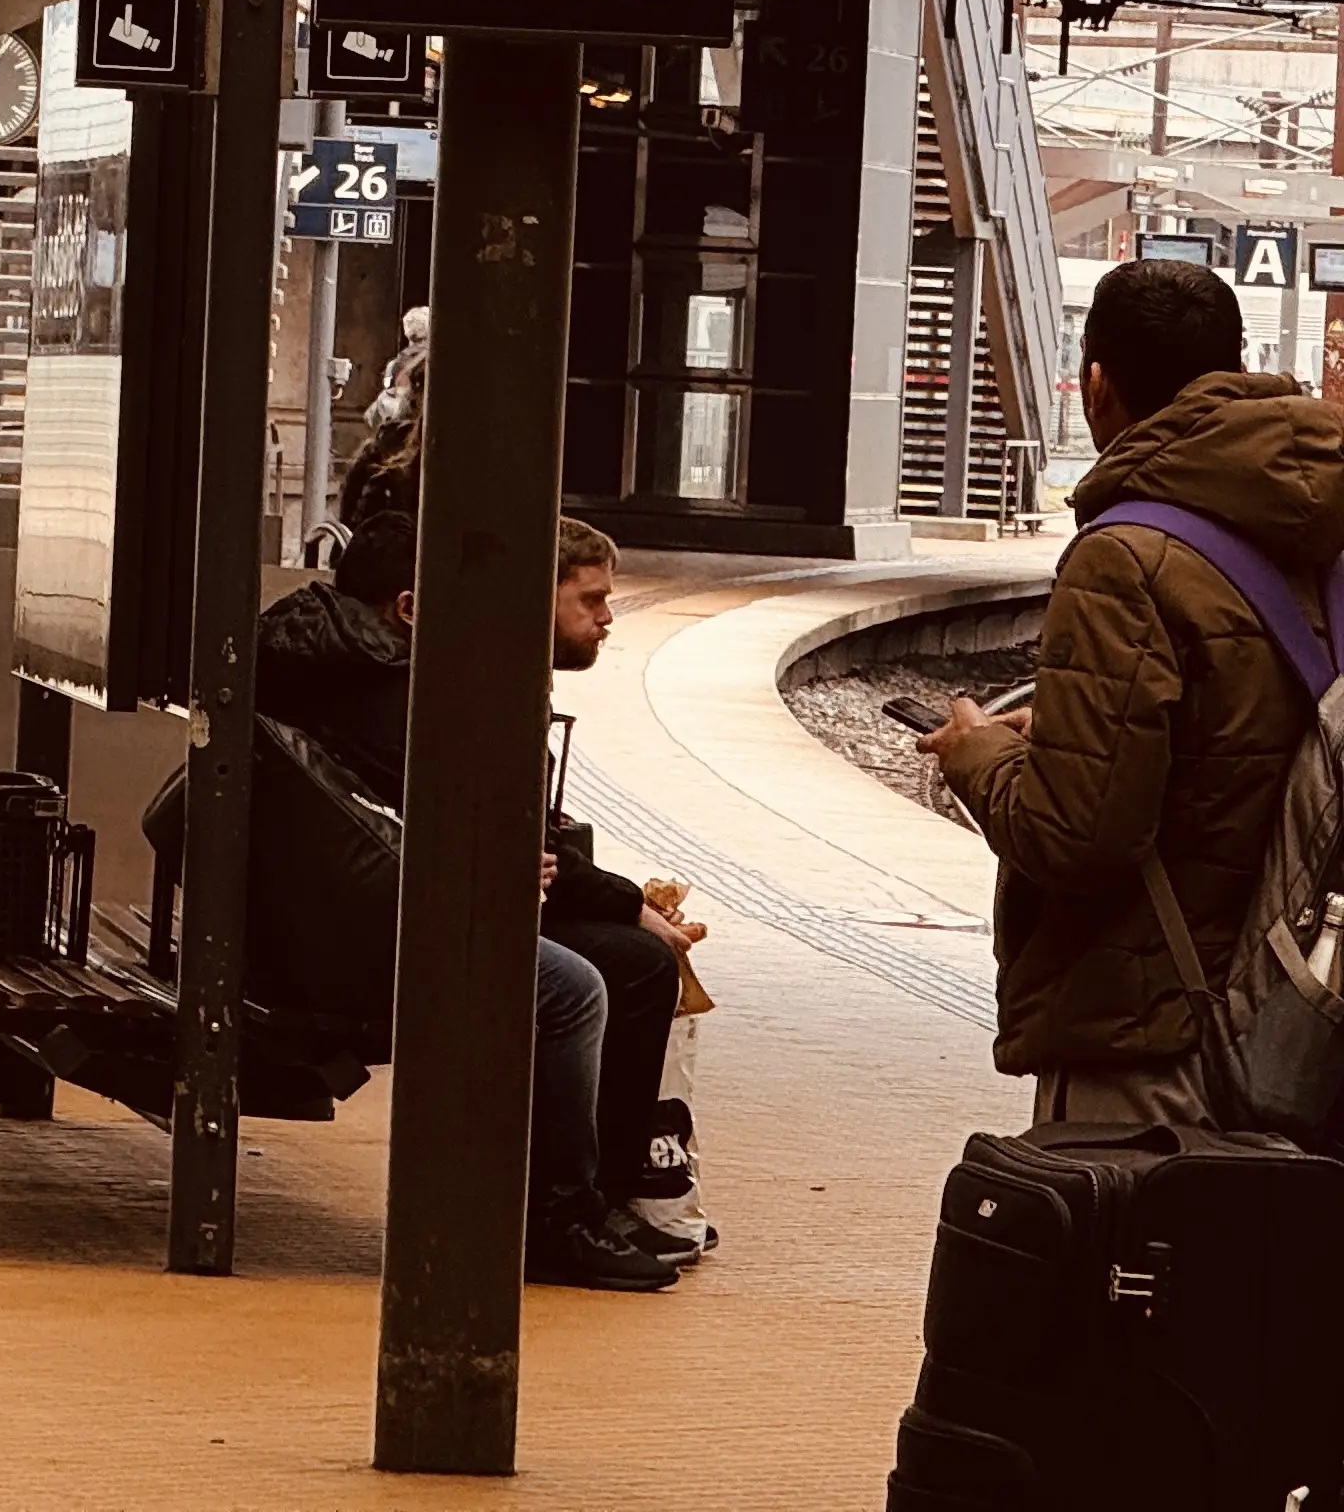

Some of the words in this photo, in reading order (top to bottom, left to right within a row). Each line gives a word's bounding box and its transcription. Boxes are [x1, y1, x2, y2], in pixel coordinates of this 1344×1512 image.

[806, 43, 850, 75] 26
[334, 164, 388, 201] 26
[1243, 239, 1287, 285] A
